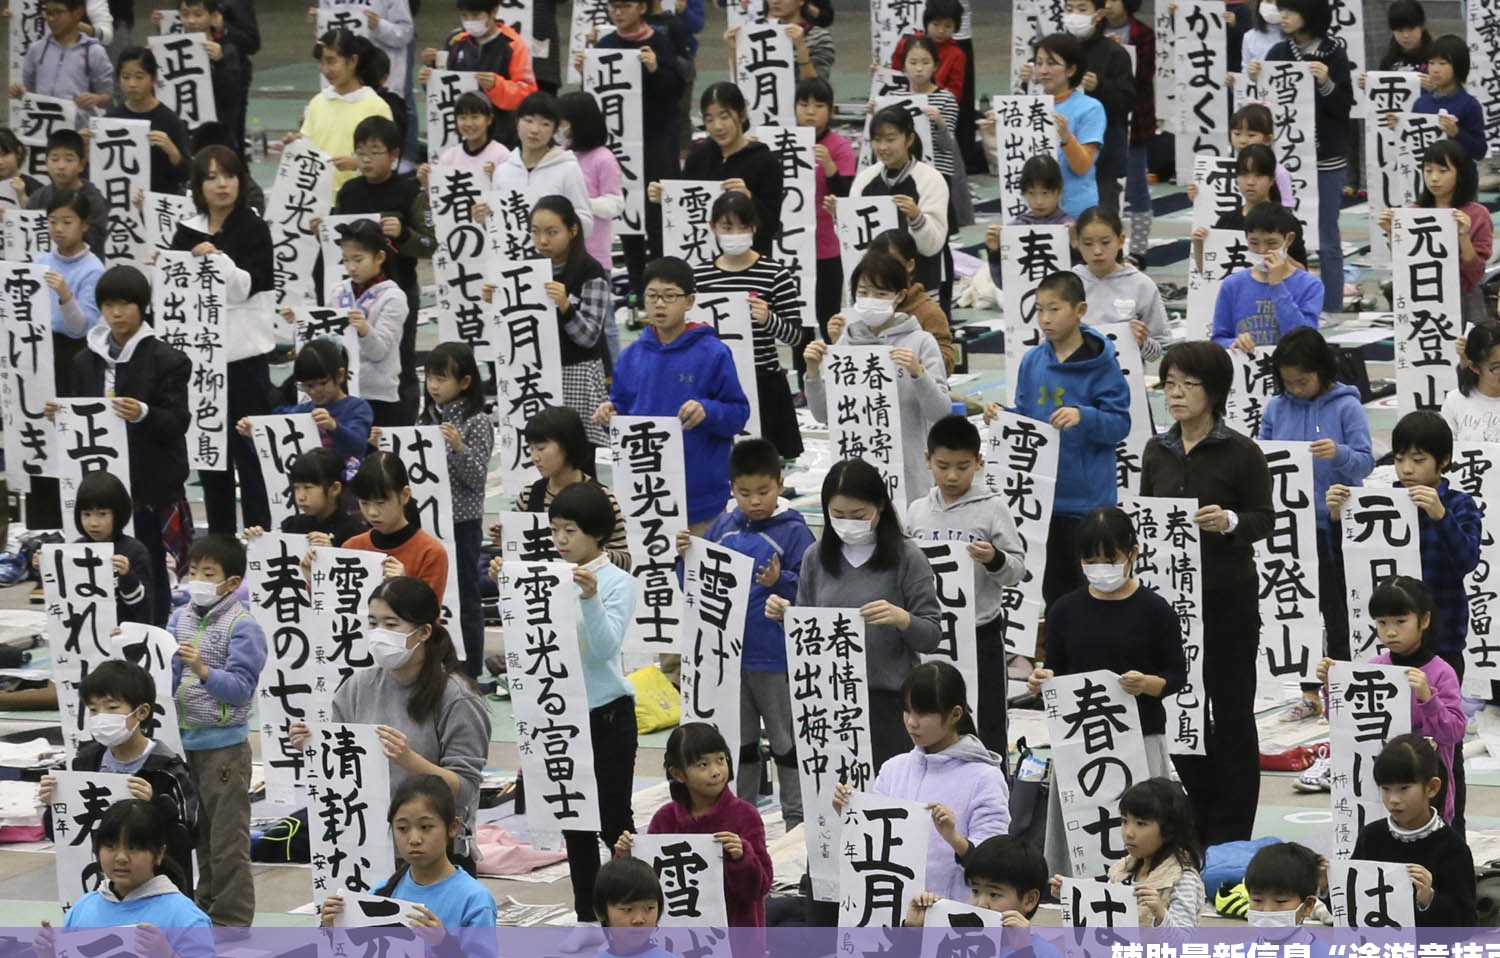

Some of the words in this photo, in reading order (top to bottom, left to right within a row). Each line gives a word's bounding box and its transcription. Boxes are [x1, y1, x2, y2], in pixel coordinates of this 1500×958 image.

[163, 38, 204, 124] 正月
[998, 101, 1027, 219] 語出梅中
[438, 170, 487, 347] 春の七草
[4, 269, 44, 476] 雪げしき
[193, 257, 224, 466] 春情寄柳色鳥
[609, 427, 622, 468] 中一年
[312, 571, 326, 617] 中一年
[497, 571, 514, 626] 中一年
[621, 422, 679, 645] 雪光る富士
[1260, 450, 1315, 678] 元日登山
[514, 566, 586, 821] 雪光る富士
[789, 618, 831, 797] 語出梅中
[827, 612, 873, 792] 春情寄柳
[1043, 688, 1062, 721] 四年
[53, 802, 72, 837] 四年
[305, 747, 320, 802] 中二年
[319, 727, 371, 892] 清新な
[844, 808, 859, 858] 六年
